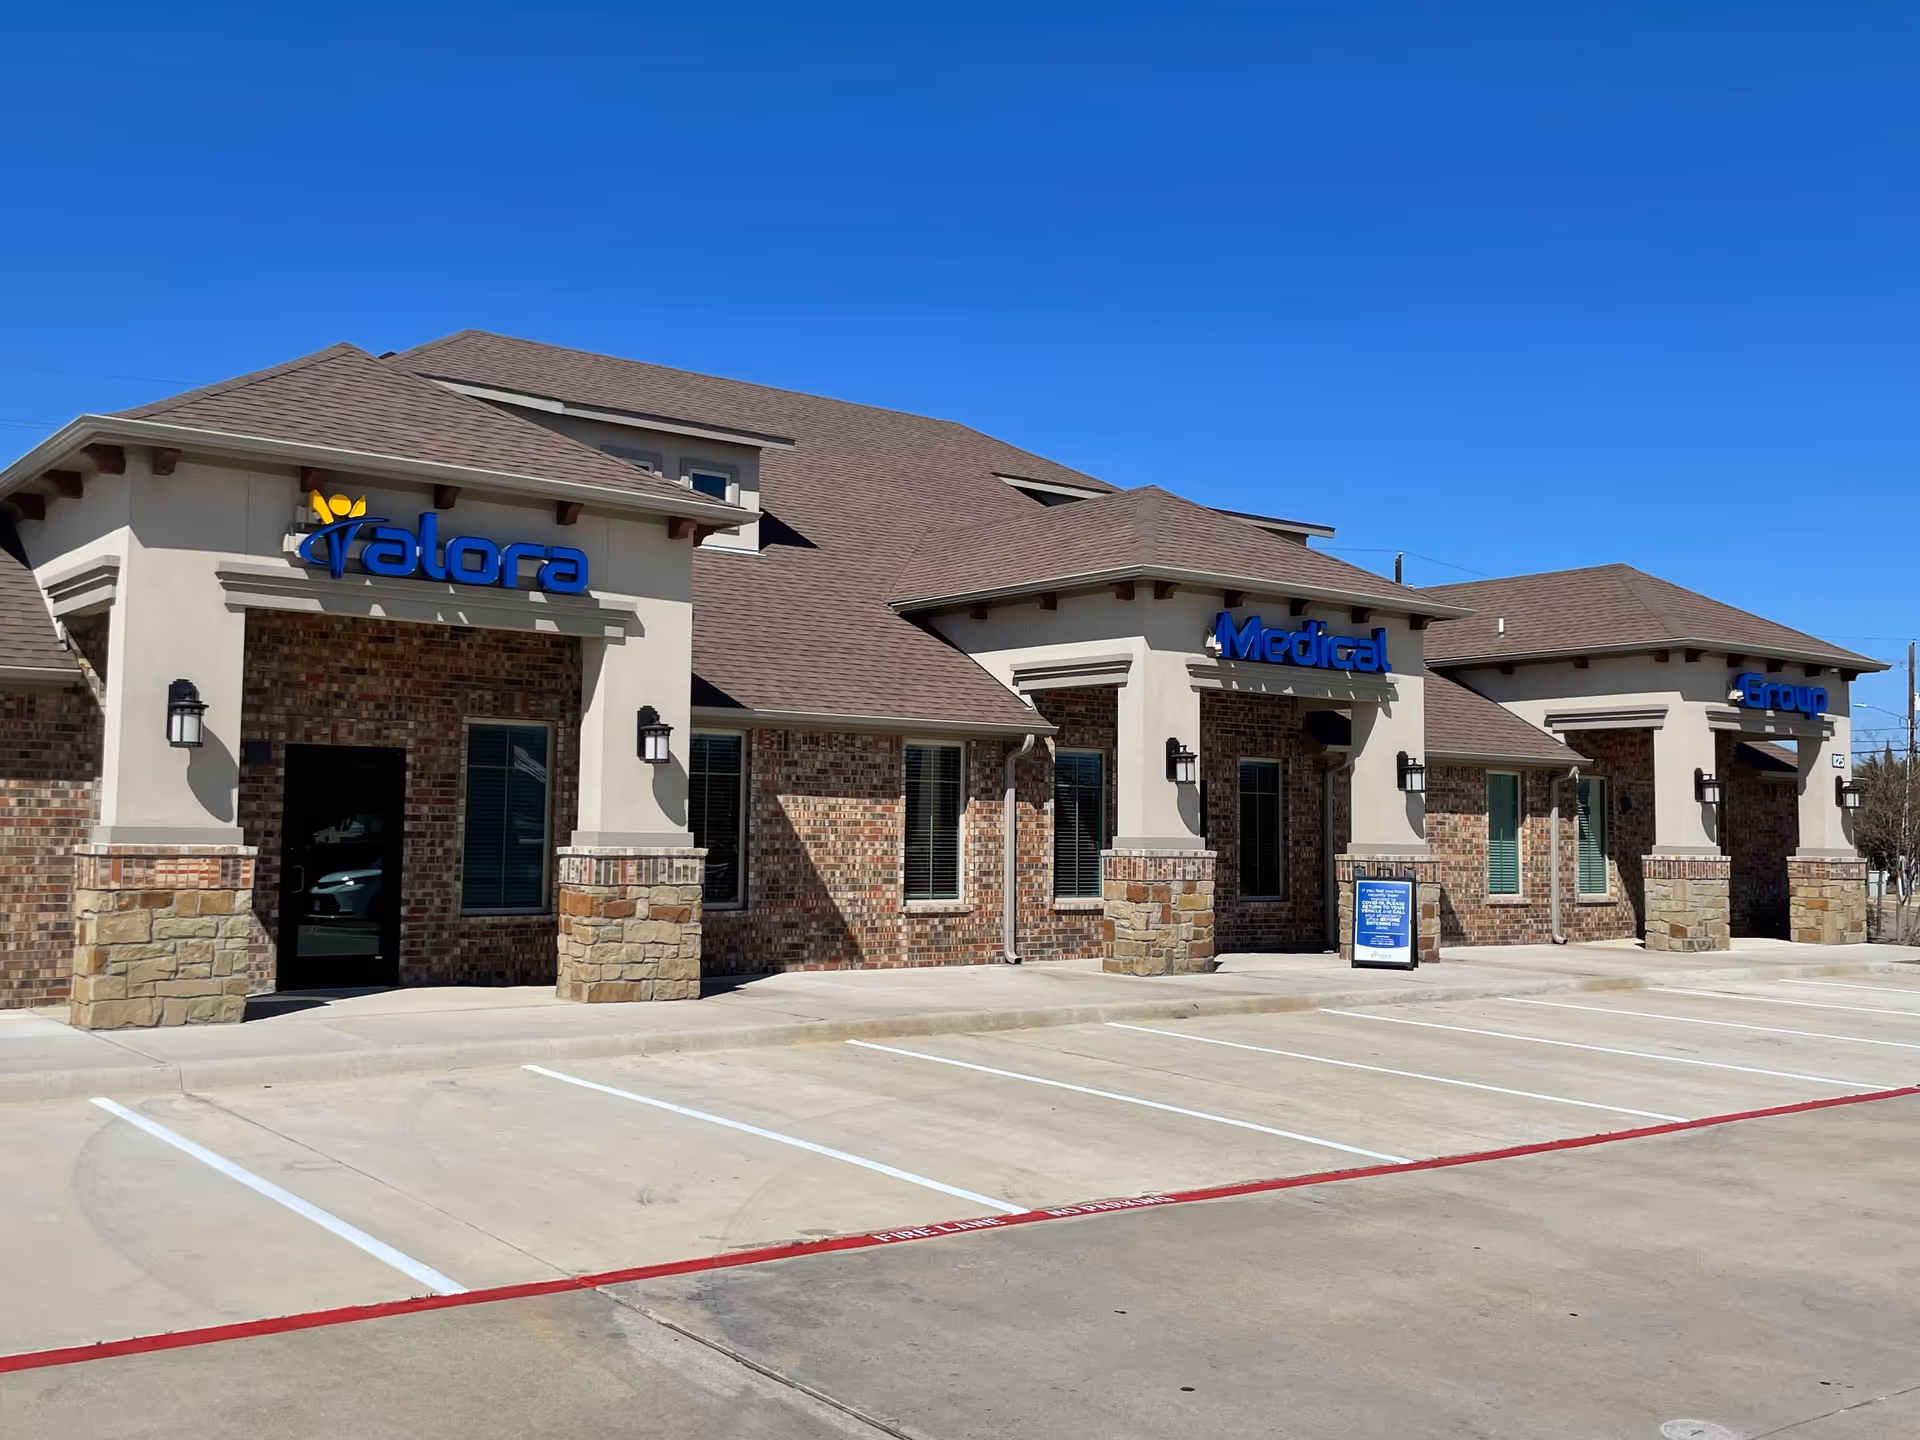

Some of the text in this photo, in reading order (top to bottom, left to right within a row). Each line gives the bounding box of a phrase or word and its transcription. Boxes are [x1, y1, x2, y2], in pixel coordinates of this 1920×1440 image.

[1215, 611, 1392, 674] Medical
[1736, 672, 1828, 720] Group
[1833, 755, 1845, 767] 825
[873, 1195, 1176, 1243] FIRE LANE NO PARKING
